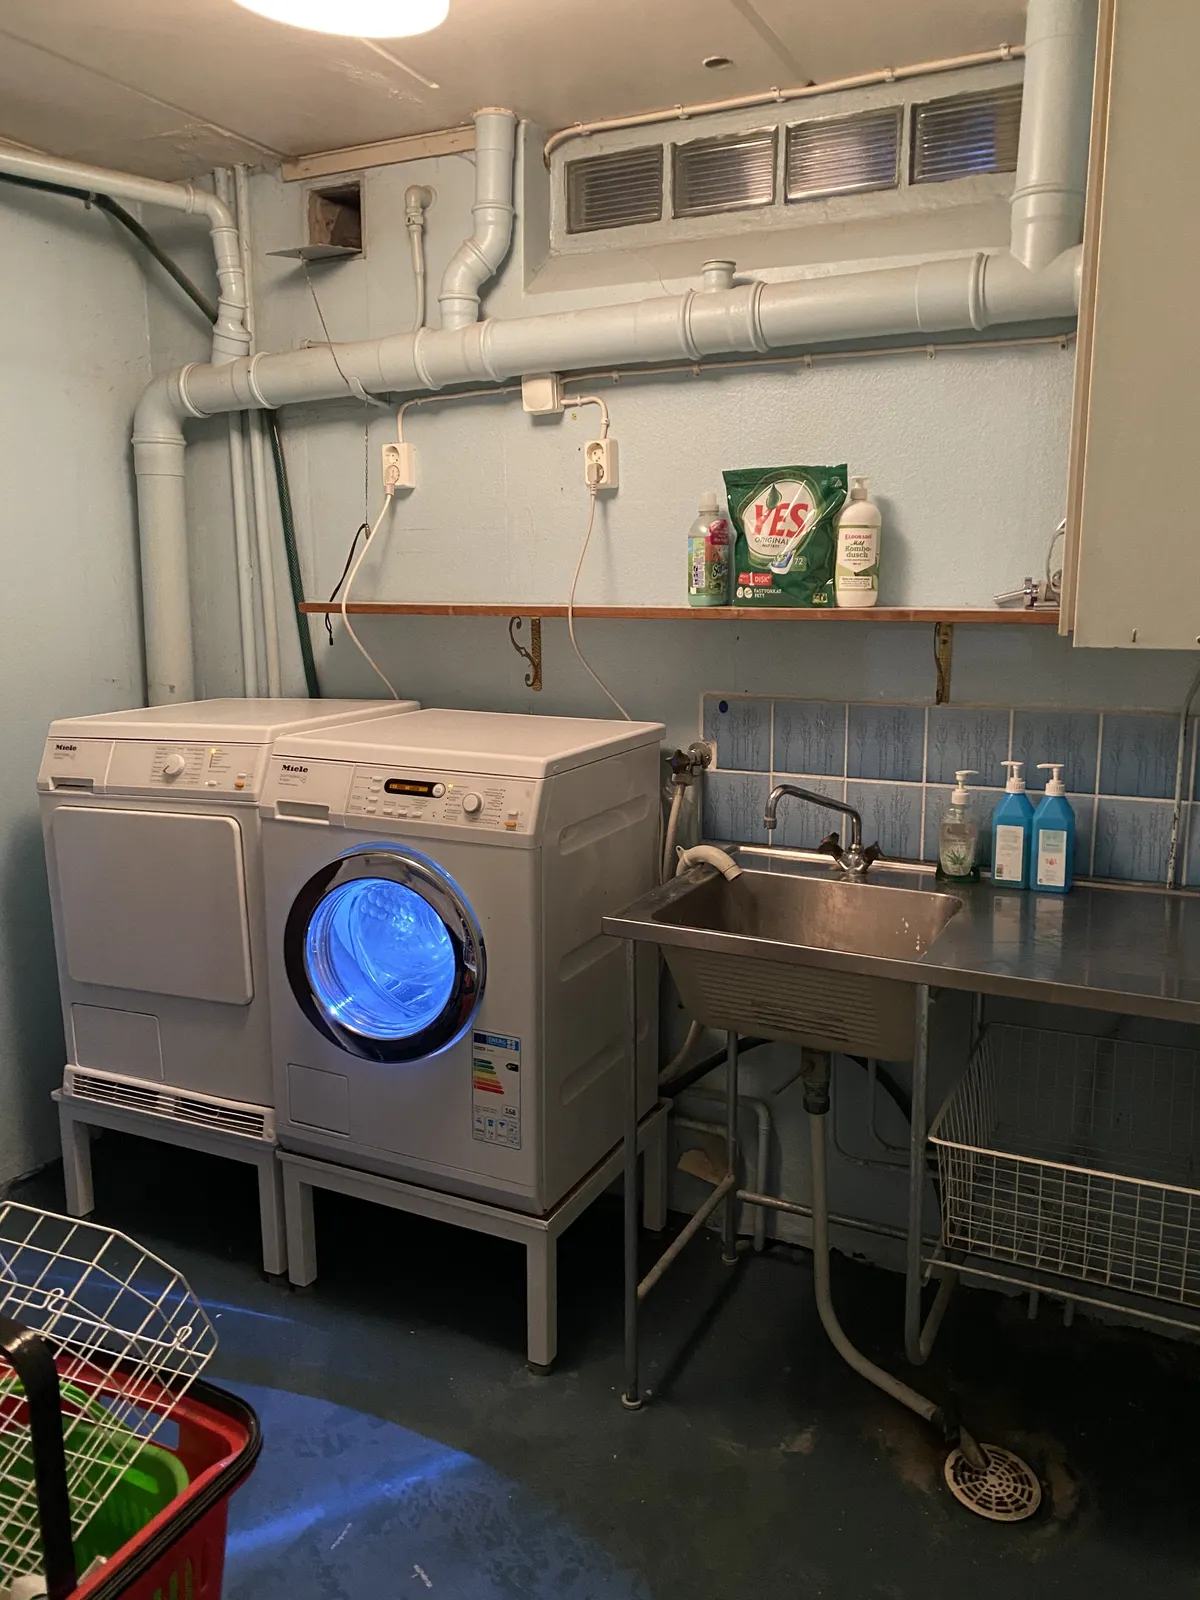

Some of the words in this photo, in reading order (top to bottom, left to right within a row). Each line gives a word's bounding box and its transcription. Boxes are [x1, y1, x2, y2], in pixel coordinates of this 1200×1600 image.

[752, 503, 809, 538] YES
[754, 537, 790, 546] ORIGINAL
[794, 558, 803, 566] 72
[749, 571, 755, 586] 1
[281, 764, 309, 773] Miele
